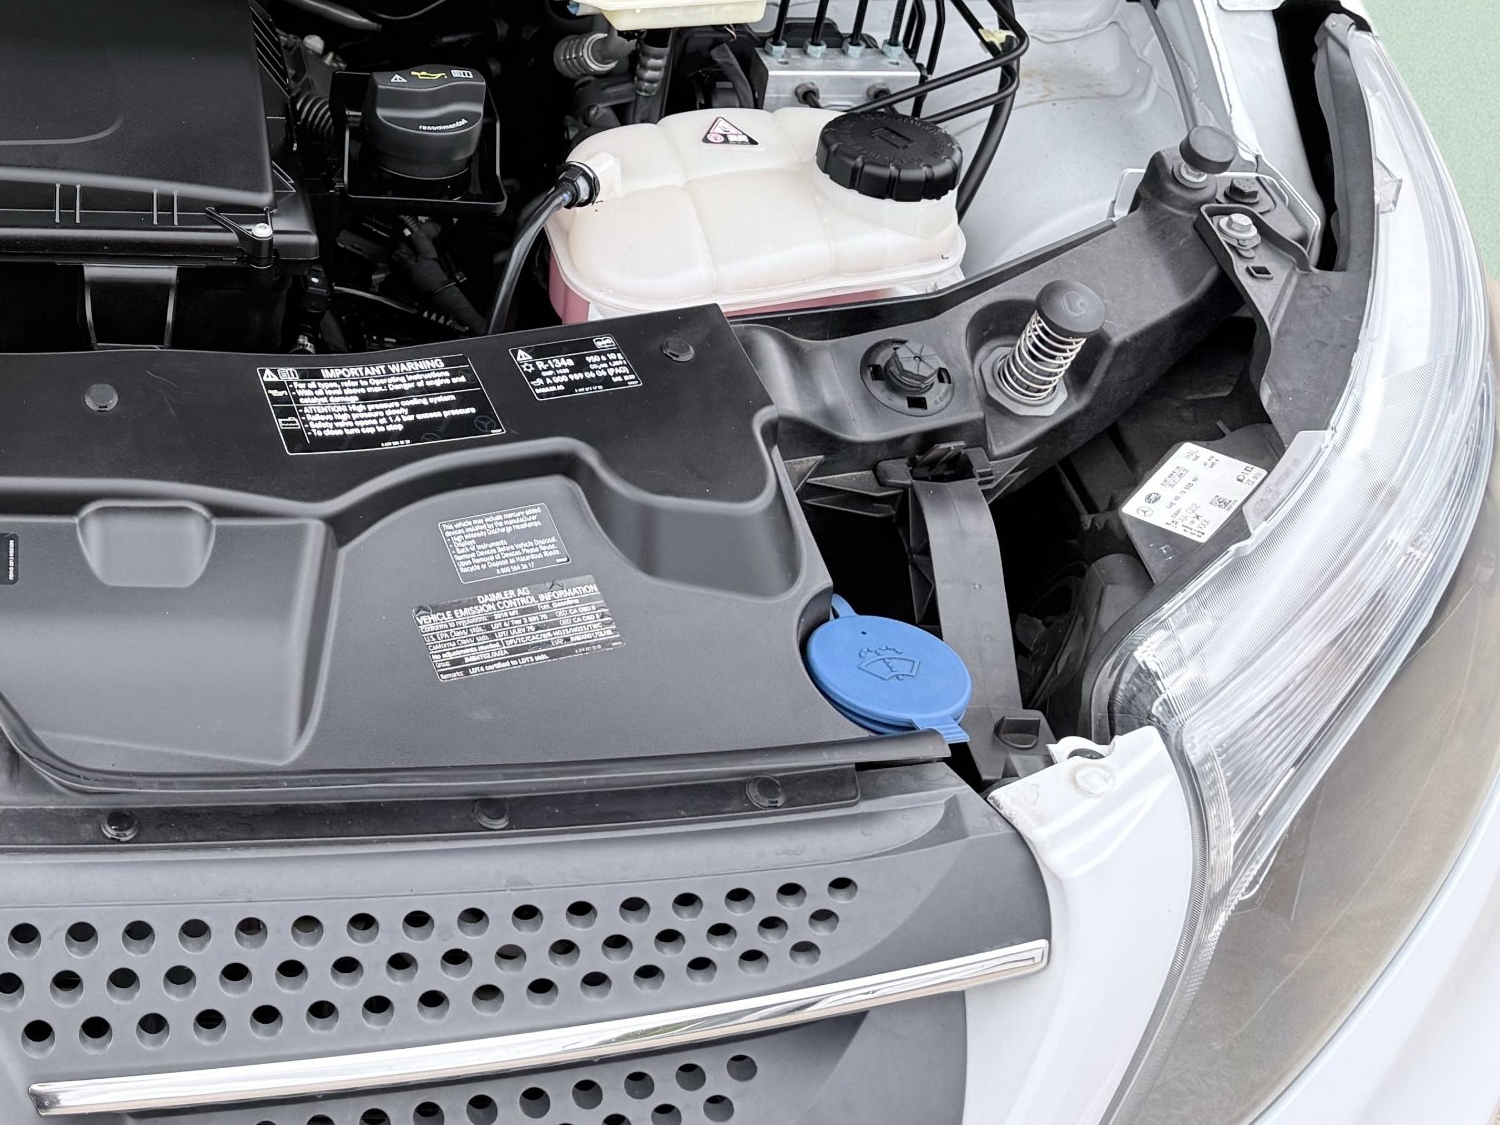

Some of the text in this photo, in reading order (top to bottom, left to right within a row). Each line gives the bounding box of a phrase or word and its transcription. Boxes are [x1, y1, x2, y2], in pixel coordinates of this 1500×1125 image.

[321, 359, 444, 378] IMPORTANT WARNING
[536, 358, 574, 370] R-134a
[369, 376, 406, 385] Operating
[388, 382, 414, 390] Danger
[426, 378, 450, 386] engine
[451, 375, 466, 383] and
[329, 396, 359, 404] damage
[367, 402, 401, 411] pressure
[429, 395, 455, 403] system
[351, 411, 384, 420] pressure
[443, 408, 476, 417] pressure
[477, 587, 530, 603] DAIMLER AG
[416, 584, 598, 624] VEHICLE EMISSION CONTROL INFORMATION
